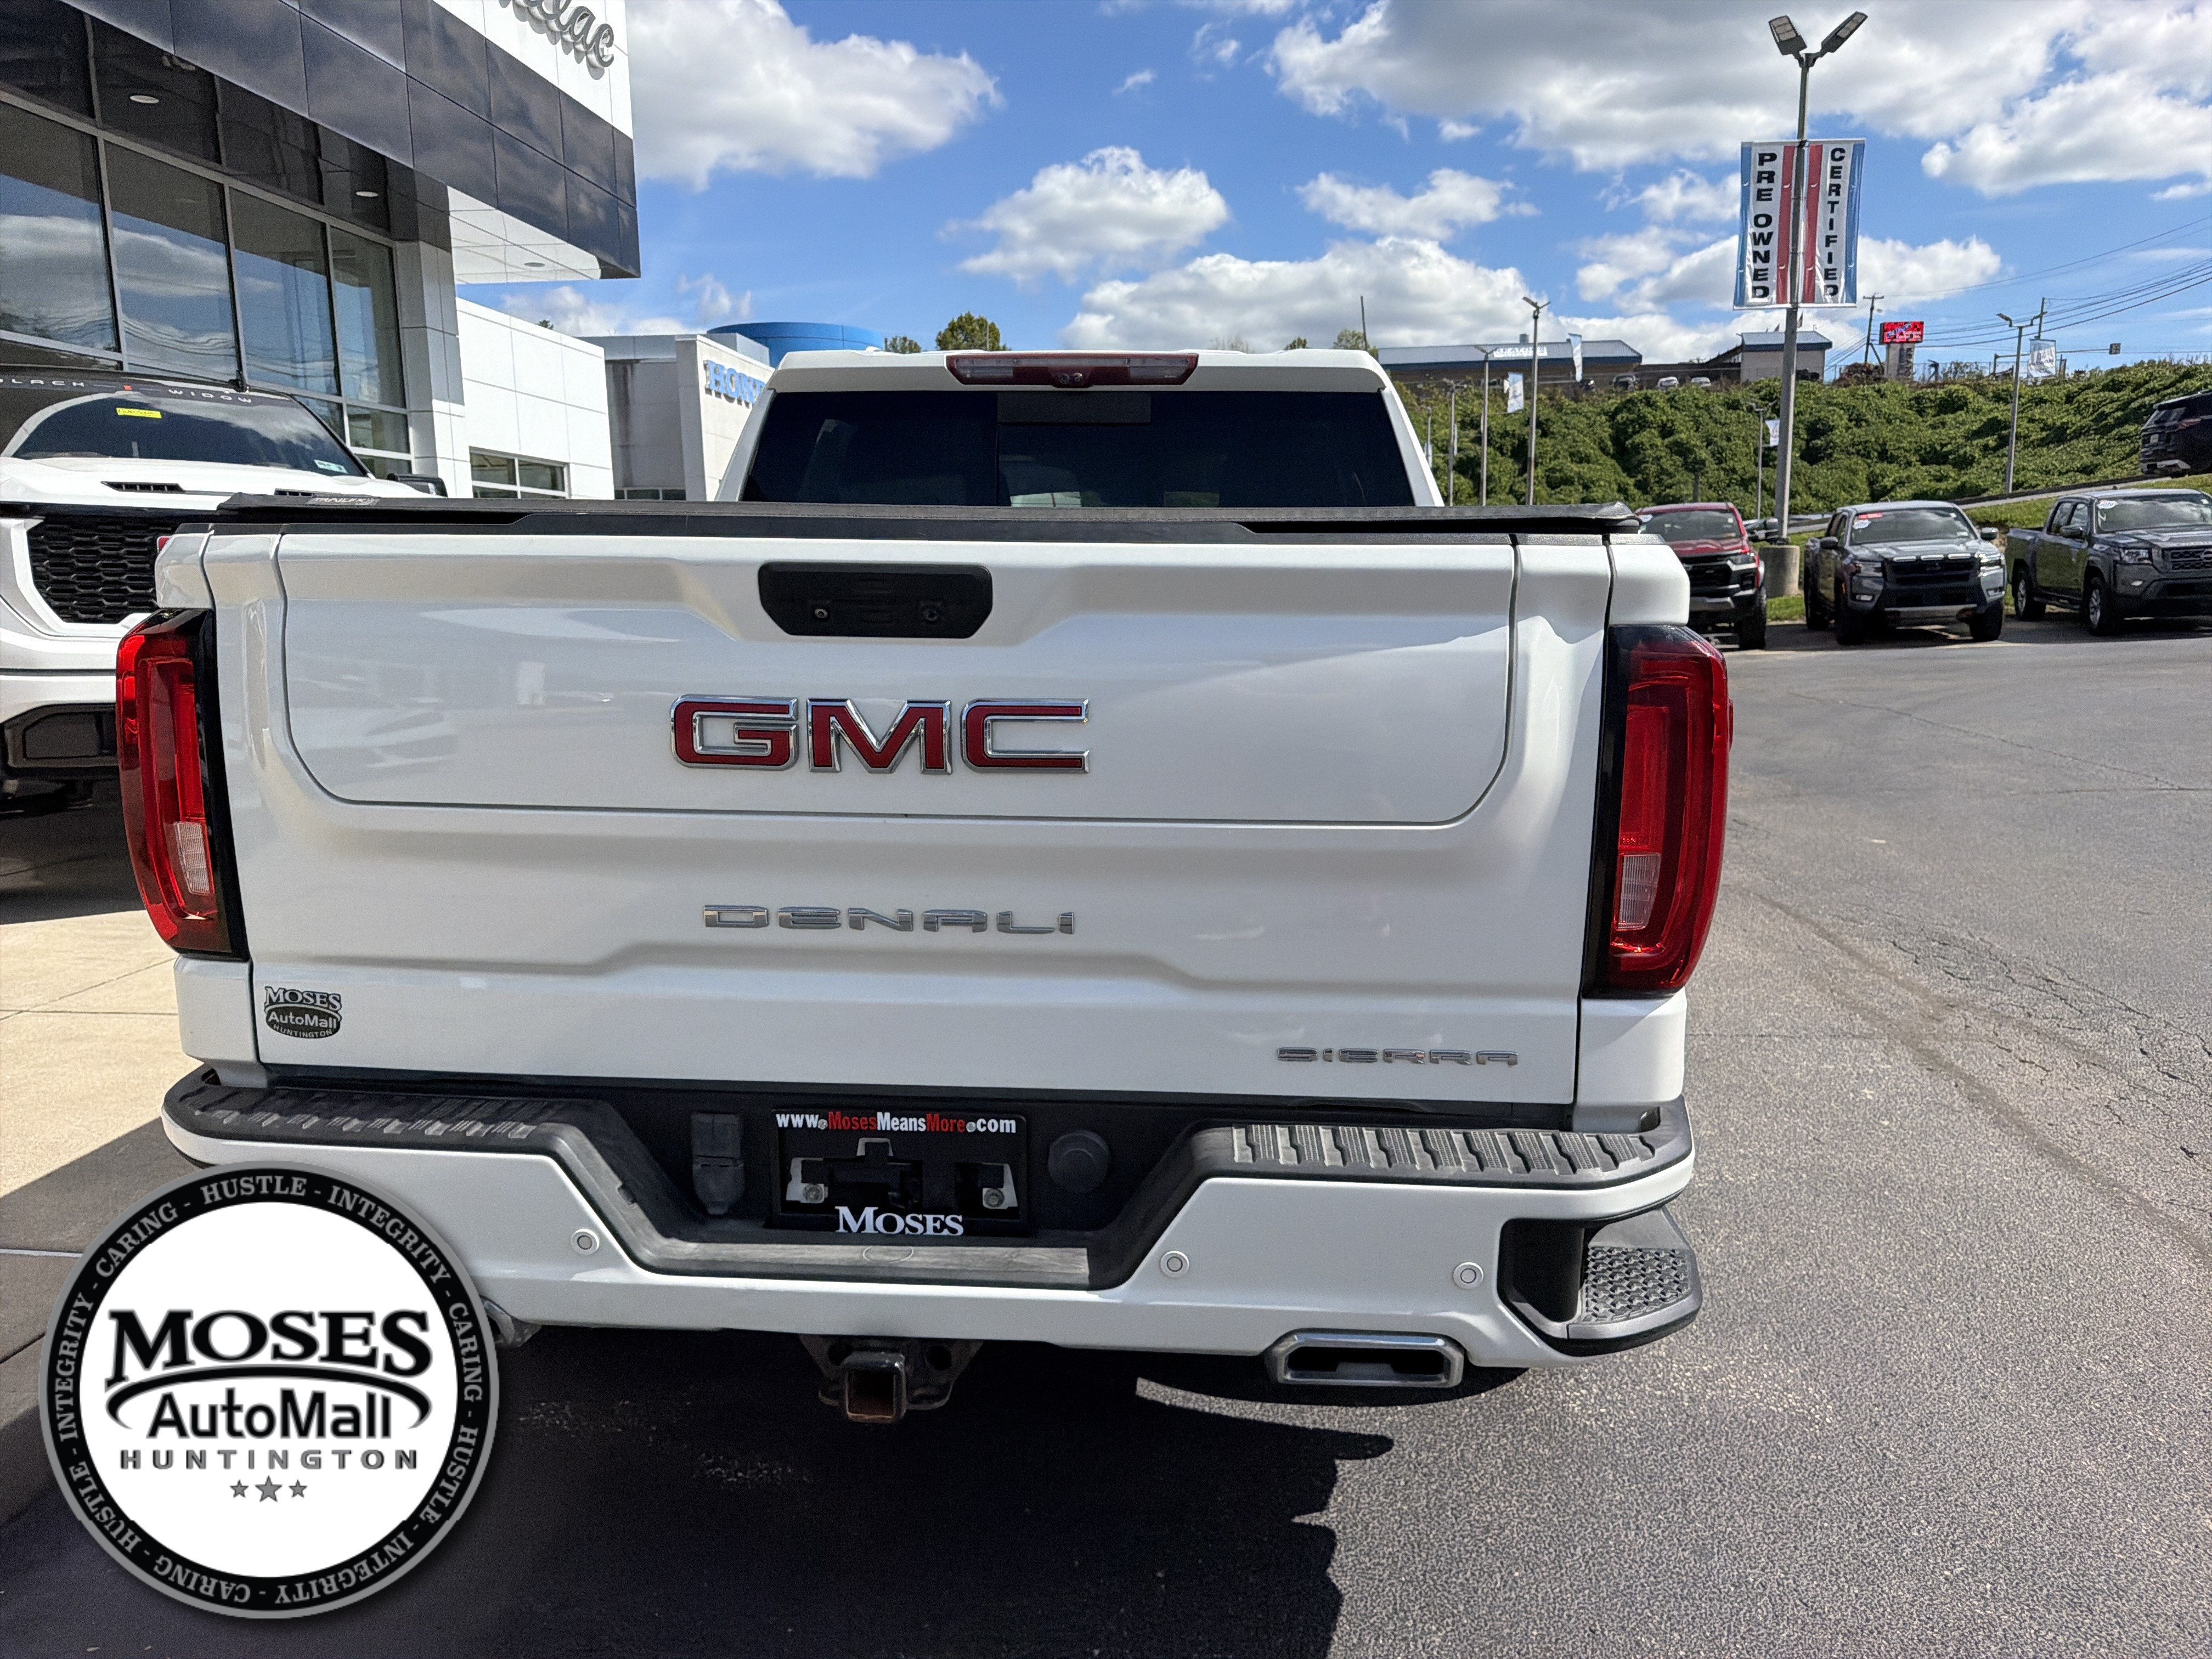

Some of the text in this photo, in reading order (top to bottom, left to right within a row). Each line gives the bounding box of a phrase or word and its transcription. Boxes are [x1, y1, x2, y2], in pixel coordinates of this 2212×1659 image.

[1752, 153, 1777, 298] PRE OWNED
[1824, 147, 1846, 297] CERTIFIED
[0, 379, 251, 403] LACK WIDOW
[670, 694, 1091, 774] GMC
[703, 905, 1075, 934] DENALI
[264, 986, 342, 1012] MOSES
[268, 1011, 337, 1029] AutoMall
[273, 1023, 332, 1038] HUNTINGTON
[1277, 1047, 1519, 1065] SIERRA
[835, 1206, 964, 1237] MOSES
